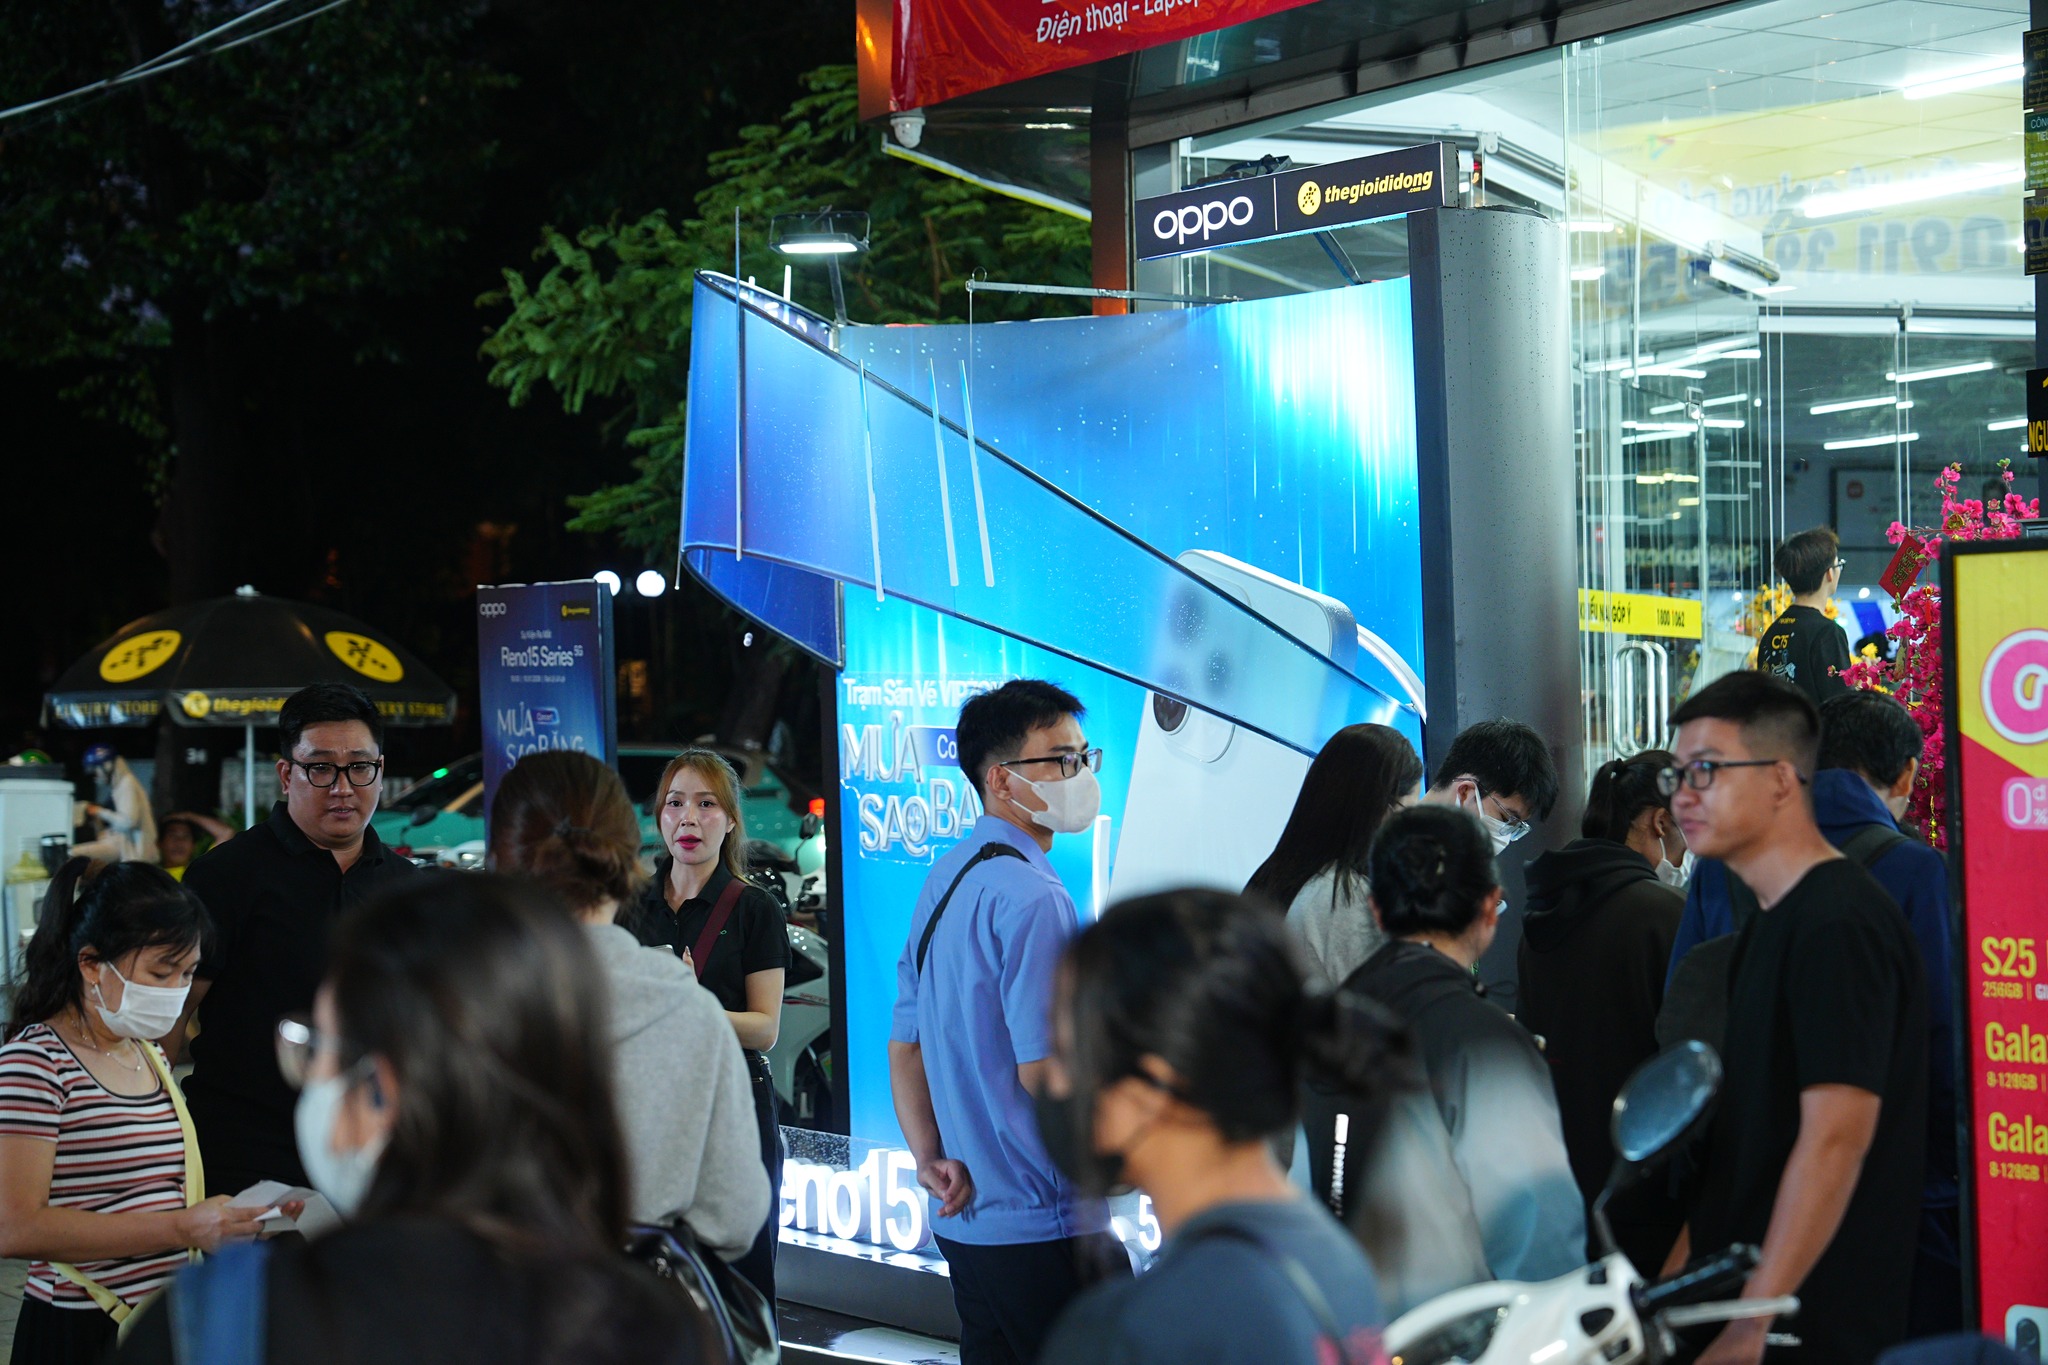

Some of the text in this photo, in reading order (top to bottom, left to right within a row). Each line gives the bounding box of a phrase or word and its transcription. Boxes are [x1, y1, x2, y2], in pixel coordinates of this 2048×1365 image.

[1037, 14, 1081, 44] Điện
[1086, 1, 1129, 31] thoại
[1324, 170, 1434, 204] thegioididong
[1153, 196, 1254, 245] oppo
[480, 602, 507, 618] oppo
[1657, 608, 1670, 626] 1800
[501, 645, 539, 668] Reno15
[540, 645, 574, 667] Series
[1771, 634, 1790, 650] C75
[843, 678, 882, 711] Trạm
[883, 678, 914, 708] Săn
[915, 679, 938, 708] Vé
[1981, 936, 2037, 978] S25
[1983, 981, 2024, 999] 256GB
[1985, 1021, 2048, 1065] Gala
[1988, 1111, 2048, 1156] Gala
[779, 1148, 928, 1251] eno15
